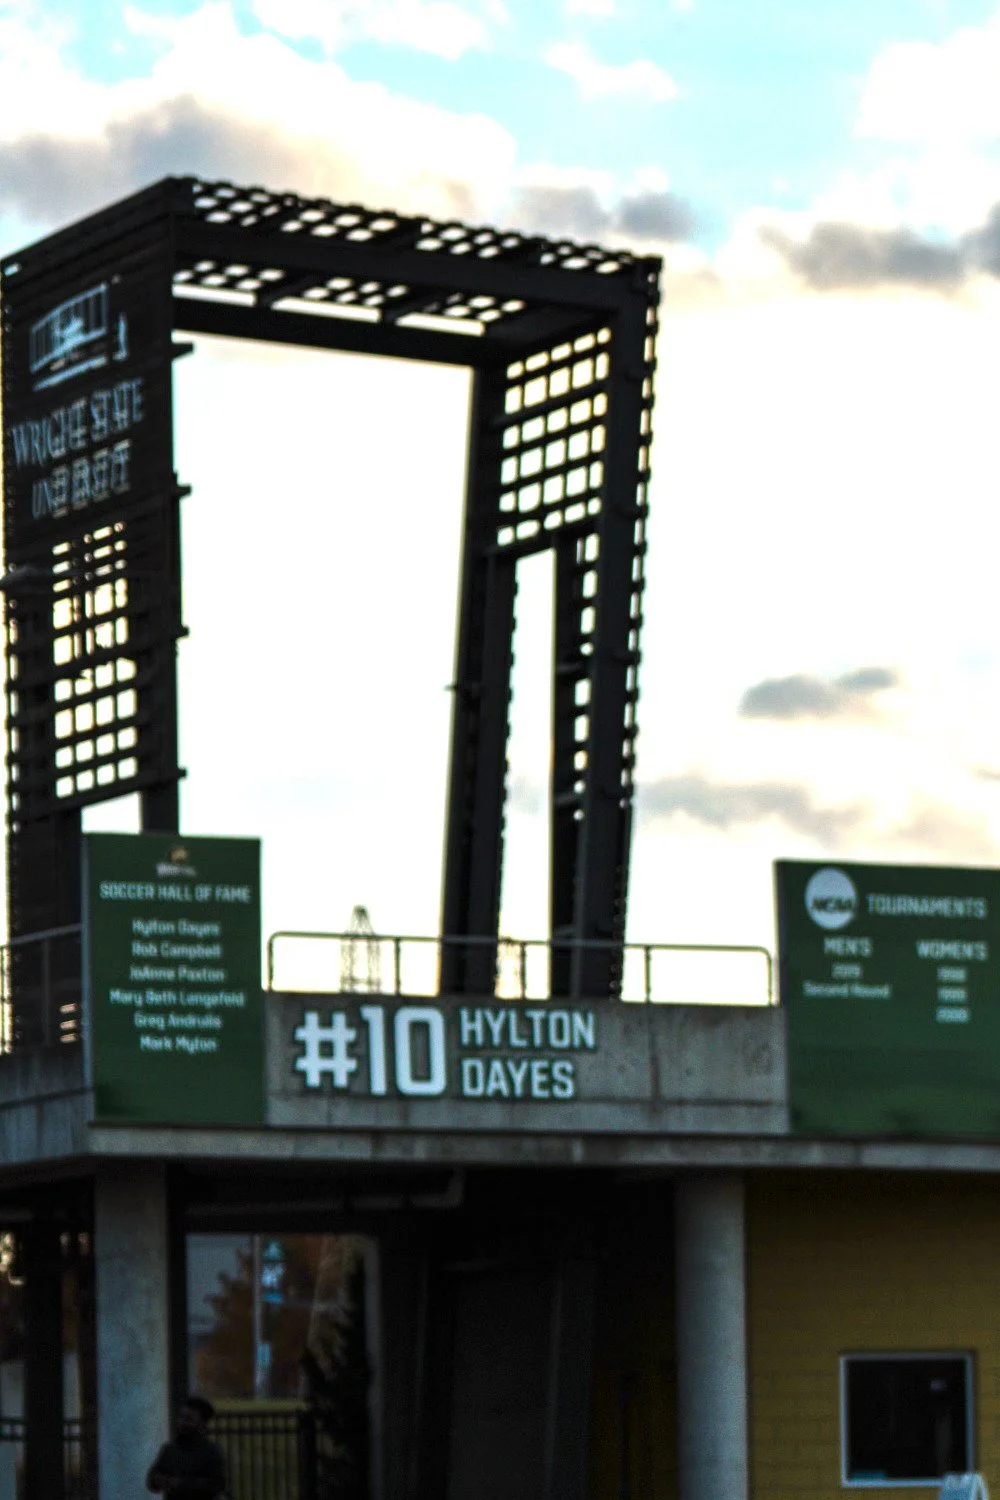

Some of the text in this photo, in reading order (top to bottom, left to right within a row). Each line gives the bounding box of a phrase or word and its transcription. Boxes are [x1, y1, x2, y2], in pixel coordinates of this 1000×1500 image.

[99, 881, 251, 903] SOCCER HALL OF FAME
[866, 894, 987, 918] TOURNAMENTS
[131, 919, 175, 938] Hylton
[160, 942, 222, 960] Campbell
[110, 989, 143, 1008] Mary
[145, 989, 177, 1004] Beth
[133, 1013, 166, 1030] Greg
[139, 1035, 173, 1050] Mark
[294, 1003, 597, 1097] #10 HYLTON
[461, 1057, 576, 1099] DAYES
